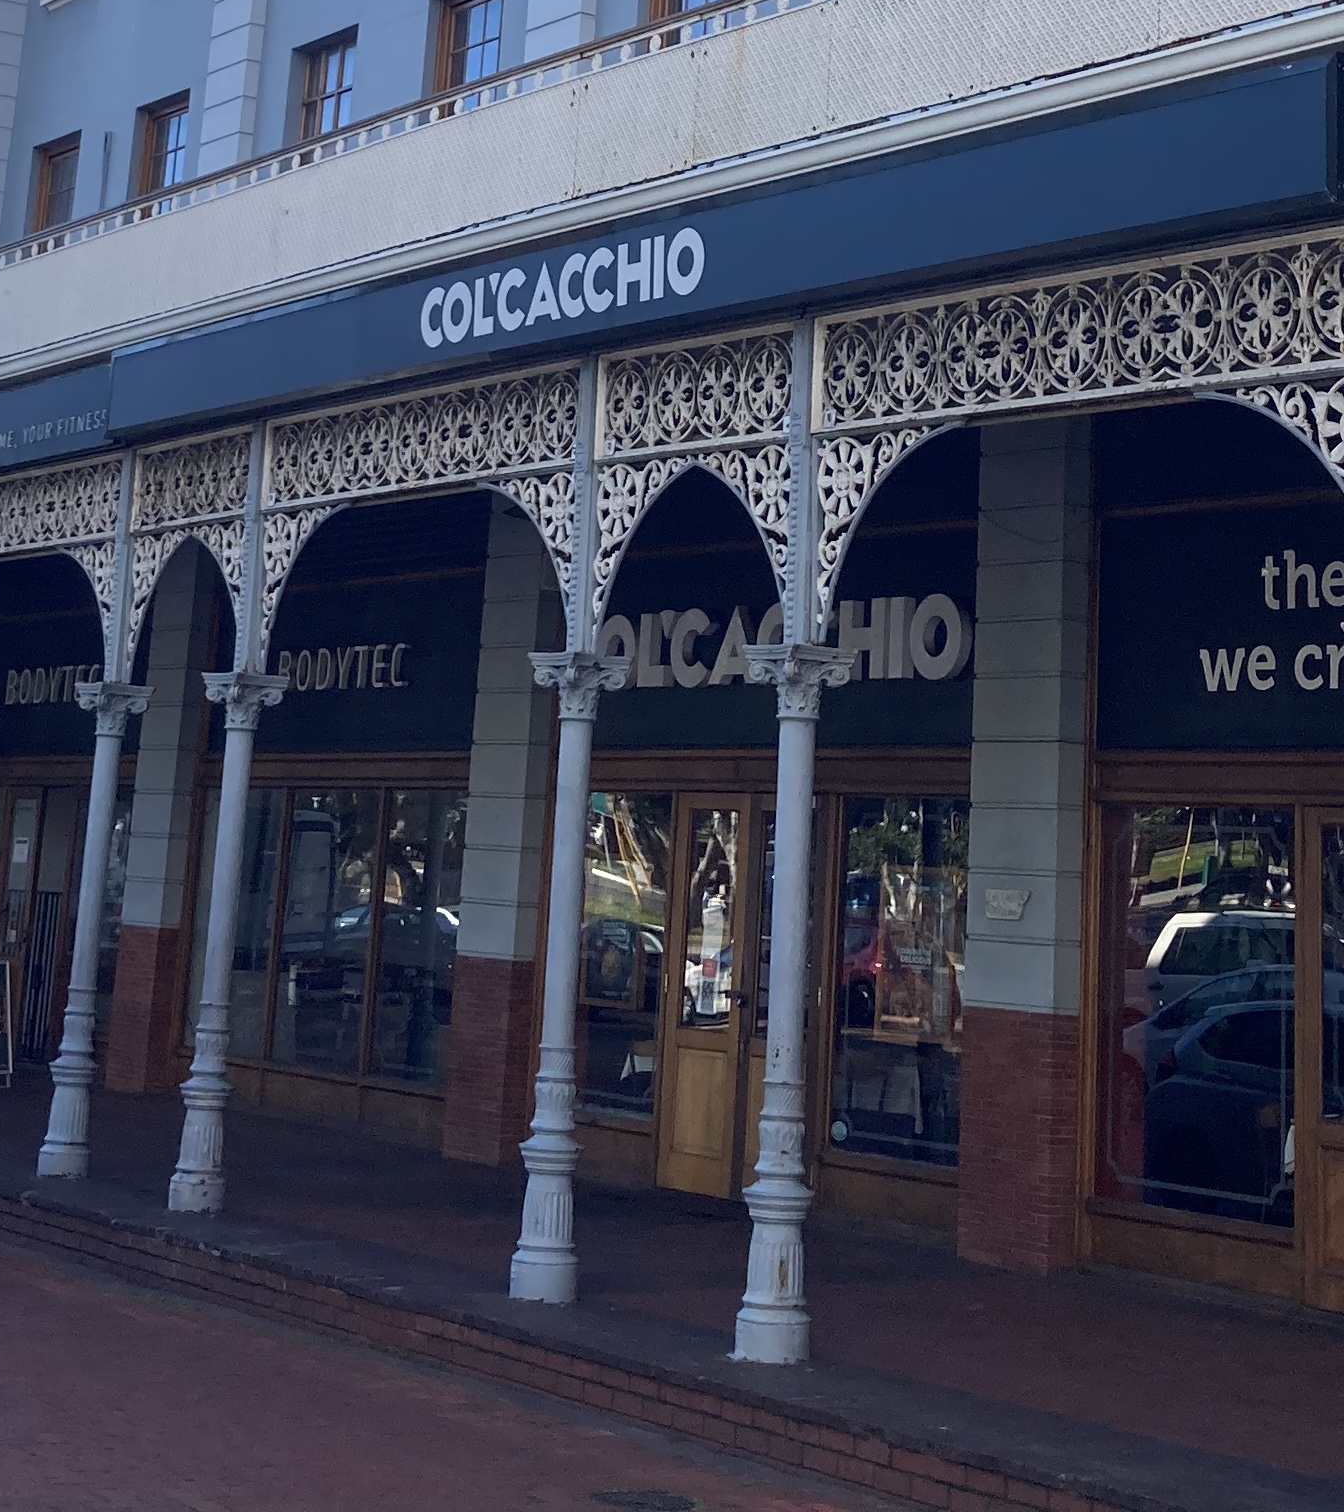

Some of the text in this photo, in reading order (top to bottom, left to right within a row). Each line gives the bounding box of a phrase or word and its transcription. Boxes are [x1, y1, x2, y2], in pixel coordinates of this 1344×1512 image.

[420, 227, 706, 348] COL'CACCHIO
[22, 422, 53, 445] YOUR
[278, 643, 407, 692] BODYTEC
[1199, 646, 1276, 692] we
